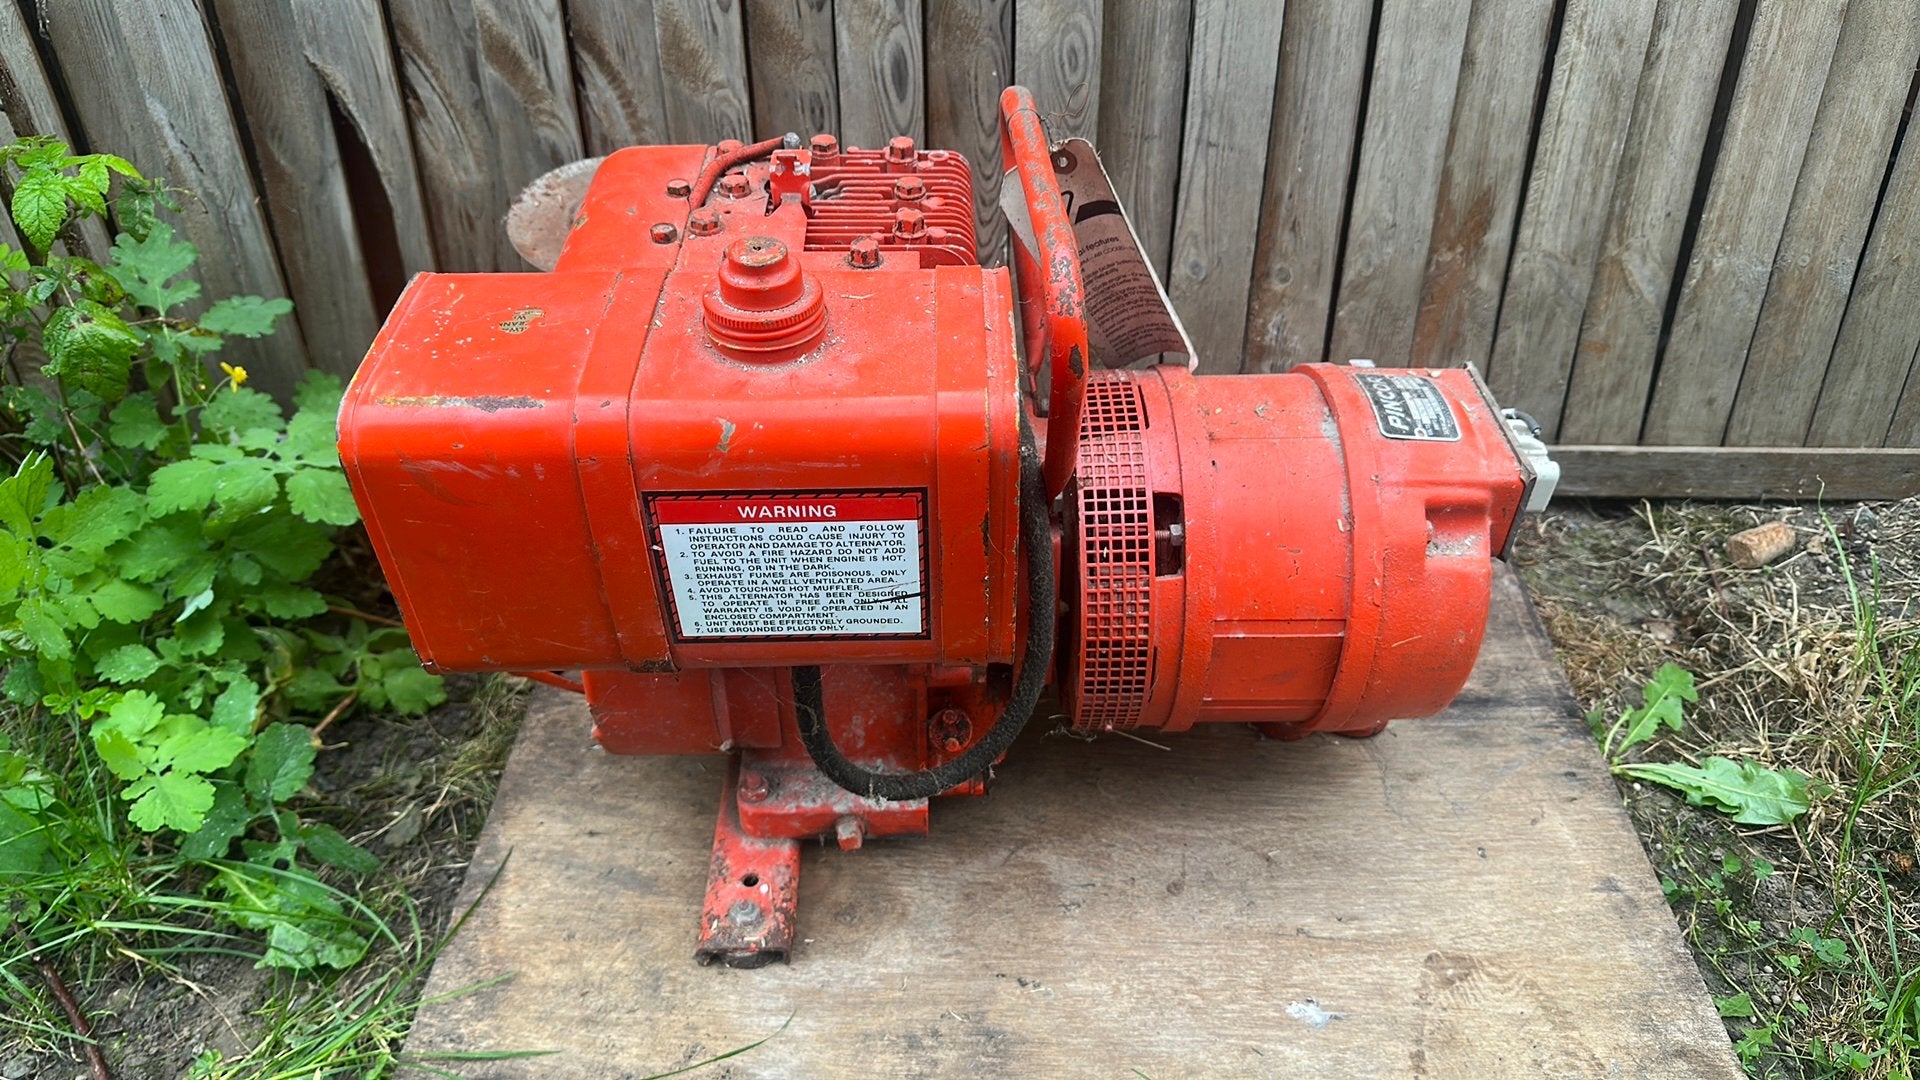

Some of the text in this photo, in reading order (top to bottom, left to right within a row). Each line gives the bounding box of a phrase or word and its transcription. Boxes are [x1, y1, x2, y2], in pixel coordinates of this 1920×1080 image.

[1086, 236, 1119, 251] features
[1366, 376, 1410, 431] PINCOR
[737, 505, 836, 518] WARNING
[689, 534, 763, 542] INSTRUCTIONS
[690, 542, 745, 550] OPERATOR
[748, 541, 770, 549] AND
[835, 539, 905, 547] ALTERNATOR.
[711, 549, 743, 557] AVOID
[790, 548, 832, 556] HAZARD
[884, 546, 905, 554] ADD
[764, 556, 787, 564] UNIT
[827, 555, 866, 563] ENGINE
[882, 554, 906, 563] HOT,
[695, 564, 744, 573] RUNNING,
[802, 577, 864, 585] VENTILATED
[728, 592, 794, 600] ALTERNATOR
[858, 590, 908, 598] DESIGNED
[779, 618, 843, 626] EFFECTIVELY
